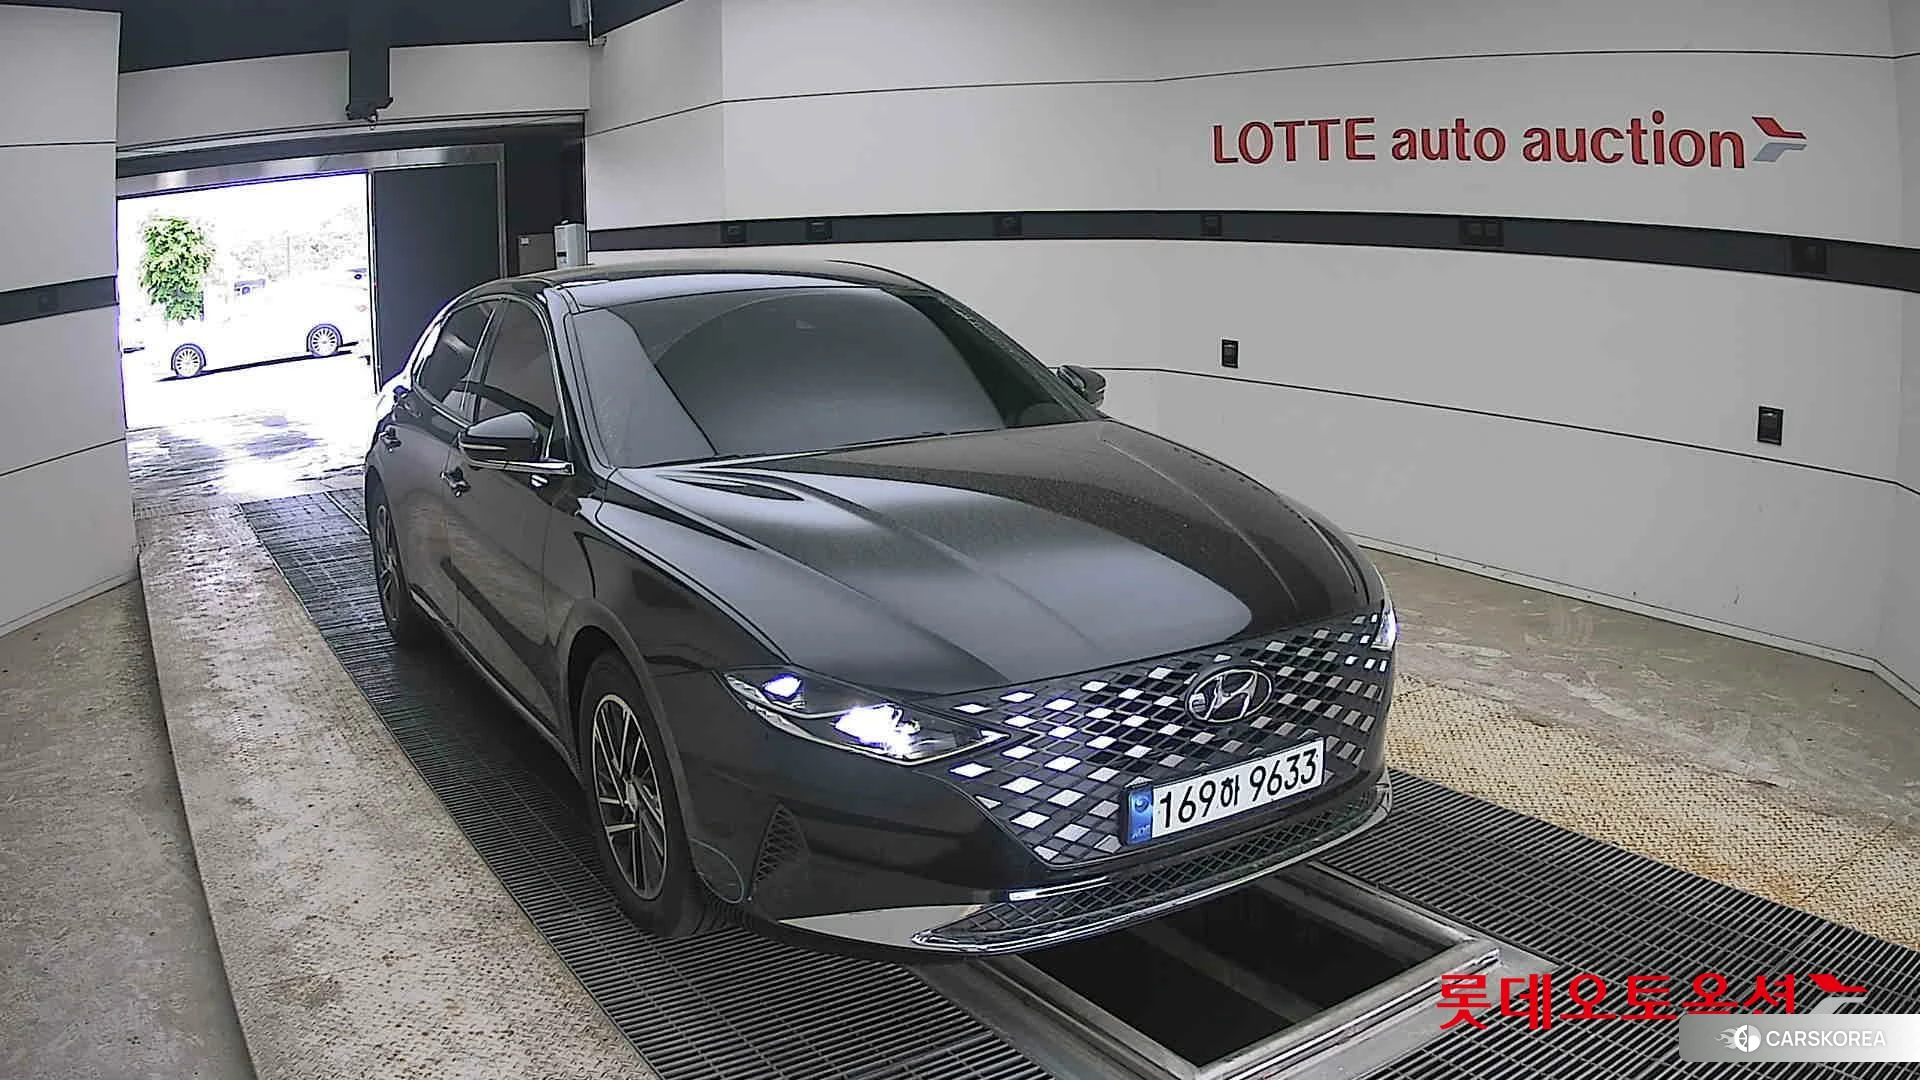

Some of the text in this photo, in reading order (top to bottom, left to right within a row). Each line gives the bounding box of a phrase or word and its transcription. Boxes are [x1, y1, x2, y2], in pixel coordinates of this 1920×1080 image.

[1212, 110, 1746, 169] LOTTE auto auction
[1159, 748, 1318, 828] 169하 9633
